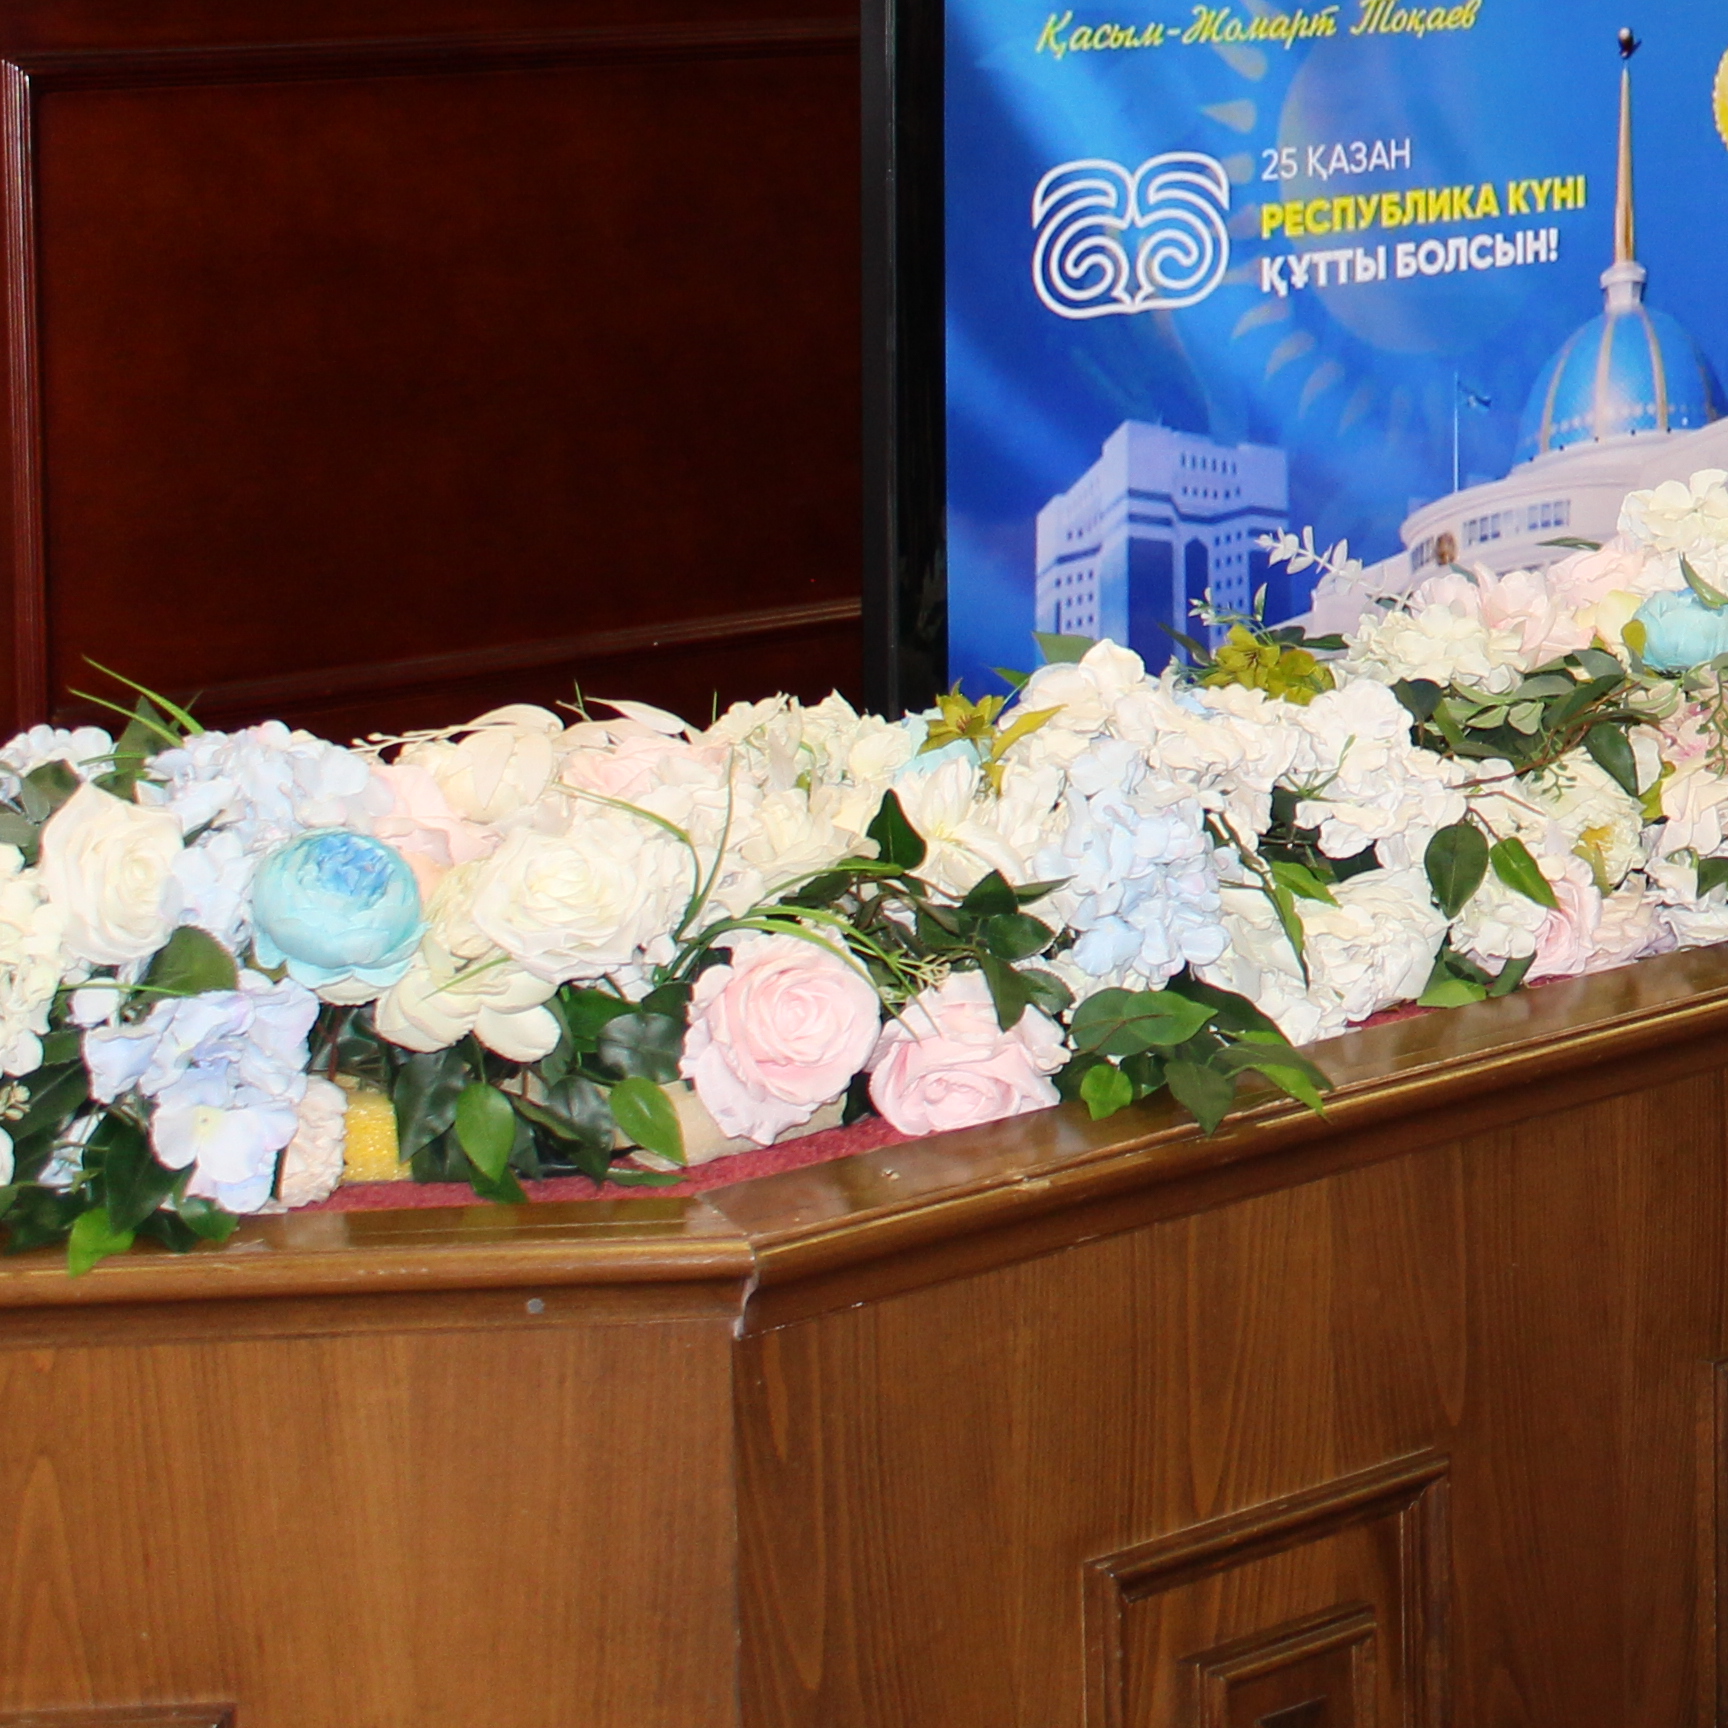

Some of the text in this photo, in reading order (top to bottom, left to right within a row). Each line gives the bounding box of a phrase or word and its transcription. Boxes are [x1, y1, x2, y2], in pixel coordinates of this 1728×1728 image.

[1035, 3, 1340, 61] Қасым-Жомарт
[1261, 137, 1411, 182] 25 ҚАЗАН
[1261, 174, 1586, 240] РЕСПУБЛИКА КҮНІ
[1261, 227, 1560, 298] ҚҰТТЫ БОЛСЫН!
